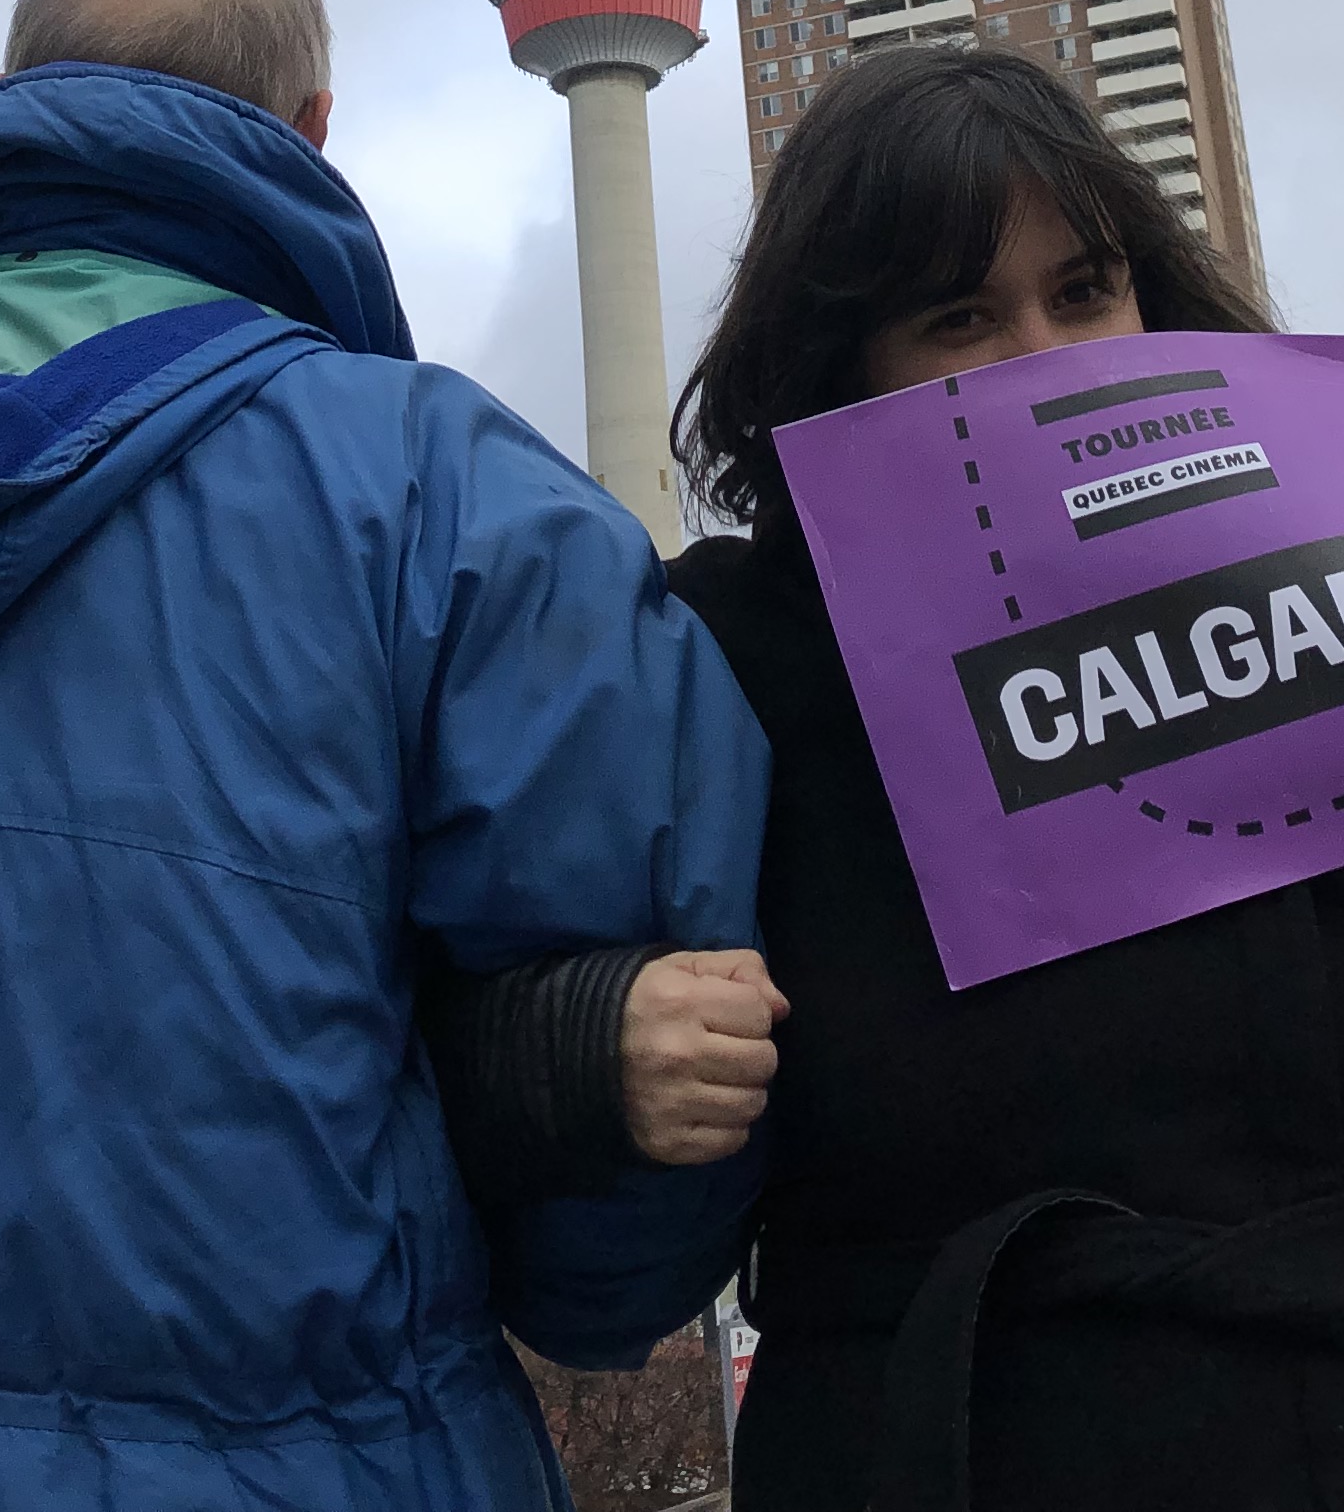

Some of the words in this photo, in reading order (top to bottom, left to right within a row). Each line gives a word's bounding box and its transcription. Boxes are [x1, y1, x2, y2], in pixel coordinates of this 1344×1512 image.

[1061, 406, 1235, 464] TOURNÉE
[1072, 471, 1164, 510] QUÉBEC
[1170, 449, 1261, 480] CINÉMA
